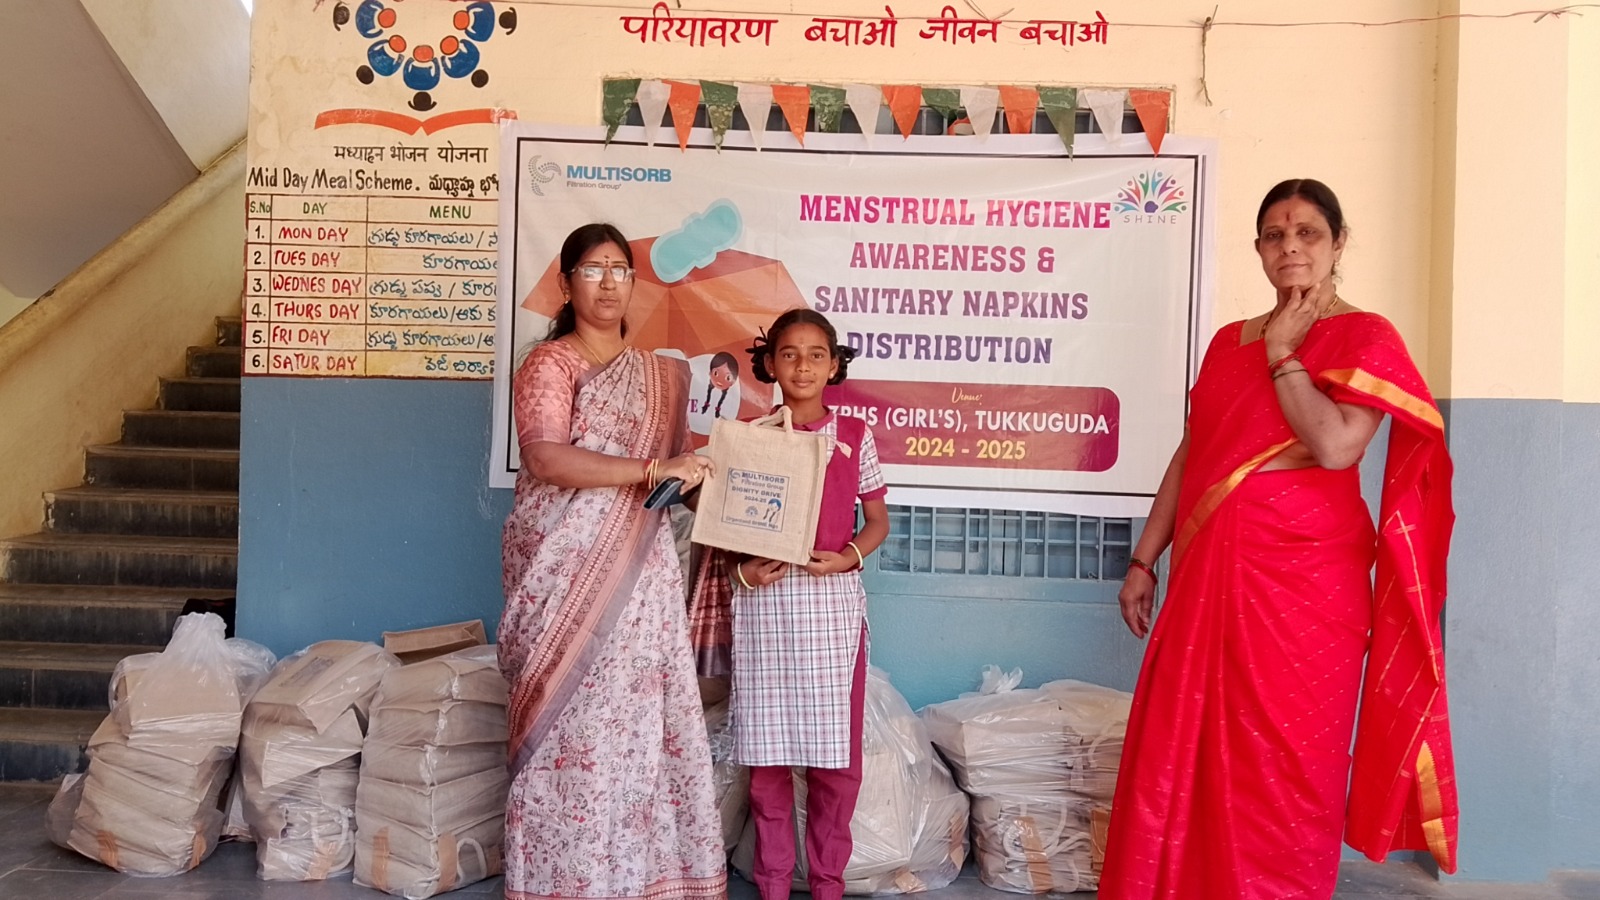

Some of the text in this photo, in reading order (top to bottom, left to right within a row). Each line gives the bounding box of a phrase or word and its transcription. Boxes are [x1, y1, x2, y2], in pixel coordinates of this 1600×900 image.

[620, 2, 1109, 48] परियावरण बचाओ जीवन बचाओ
[390, 141, 430, 162] भोजन
[437, 140, 489, 163] योजना
[247, 167, 278, 187] Mid
[283, 167, 309, 193] Day
[311, 168, 353, 189] Meal
[566, 165, 672, 182] MULTISORB
[566, 180, 597, 188] Filtration
[303, 202, 328, 215] DAY
[429, 205, 471, 219] MENU
[799, 194, 1111, 229] MENSTRUAL HYGIENE
[1123, 214, 1177, 224] SHINE
[255, 225, 348, 242] 1. MON DAY
[253, 250, 341, 267] 2. TUES DAY
[850, 241, 1055, 273] AWARENESS &
[252, 274, 362, 296] 3. WEDNES DAY
[252, 301, 360, 320] 4. THURS DAY
[814, 285, 1089, 320] SANITARY NAPKINS
[252, 325, 331, 346] 5. FRI DAY
[847, 331, 1053, 364] DISTRIBUTION
[252, 352, 358, 371] 6. SATUR DAY
[975, 410, 1110, 434] TUKKUGUDA
[905, 436, 955, 457] 2024
[976, 439, 1026, 460] 2025
[741, 471, 785, 484] MULTISORB
[731, 485, 782, 498] DIGNITY DRIVE
